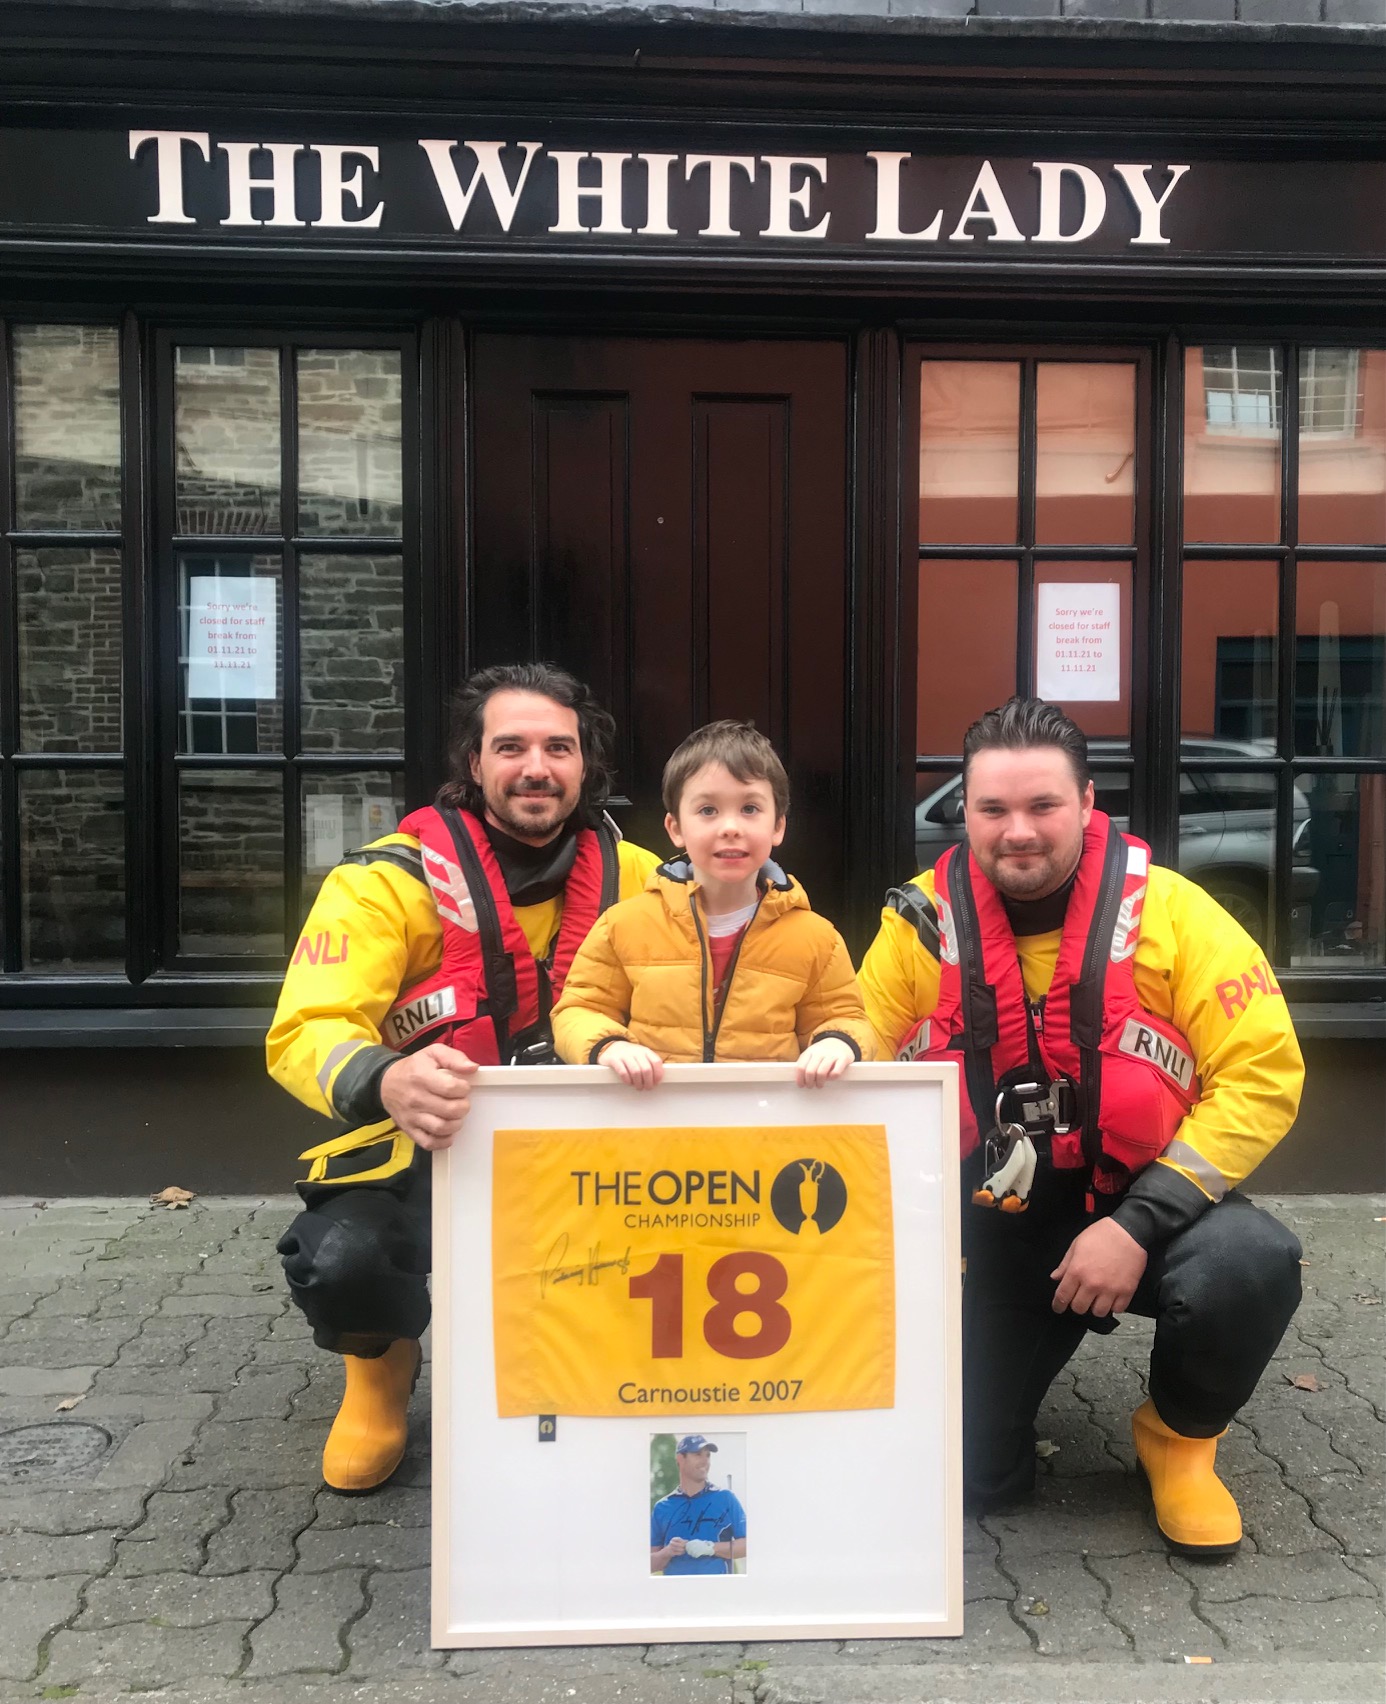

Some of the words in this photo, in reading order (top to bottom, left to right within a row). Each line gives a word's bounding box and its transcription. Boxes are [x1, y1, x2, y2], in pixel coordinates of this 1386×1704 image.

[128, 129, 385, 229] THE
[417, 139, 832, 240] WHITE
[865, 151, 1191, 245] LADY
[206, 601, 231, 612] Sorry
[232, 601, 258, 611] we're
[1055, 607, 1078, 618] Sorry
[1079, 607, 1104, 617] we're
[199, 616, 228, 626] closed
[229, 616, 243, 626] for
[244, 616, 266, 626] staff
[1048, 621, 1075, 631] closed
[1077, 621, 1090, 631] for
[1091, 621, 1111, 631] staff
[207, 630, 233, 640] break
[235, 630, 258, 640] from
[1055, 635, 1080, 645] break
[1081, 635, 1103, 645] from
[206, 645, 246, 655] 01.11.21
[247, 646, 258, 655] to
[1055, 649, 1091, 659] 01.11.21
[1093, 650, 1103, 659] to
[213, 661, 252, 669] 11.11.21
[1060, 663, 1097, 673] 11.11.21
[292, 930, 350, 966] NLI
[1215, 960, 1283, 1021] RNL
[391, 992, 444, 1041] RNLI
[1134, 1027, 1187, 1082] RNLI
[623, 1212, 761, 1229] CHAMPIONSHIP
[628, 1250, 792, 1361] 18
[617, 1382, 741, 1405] Carnoustie
[748, 1379, 804, 1402] 2007
